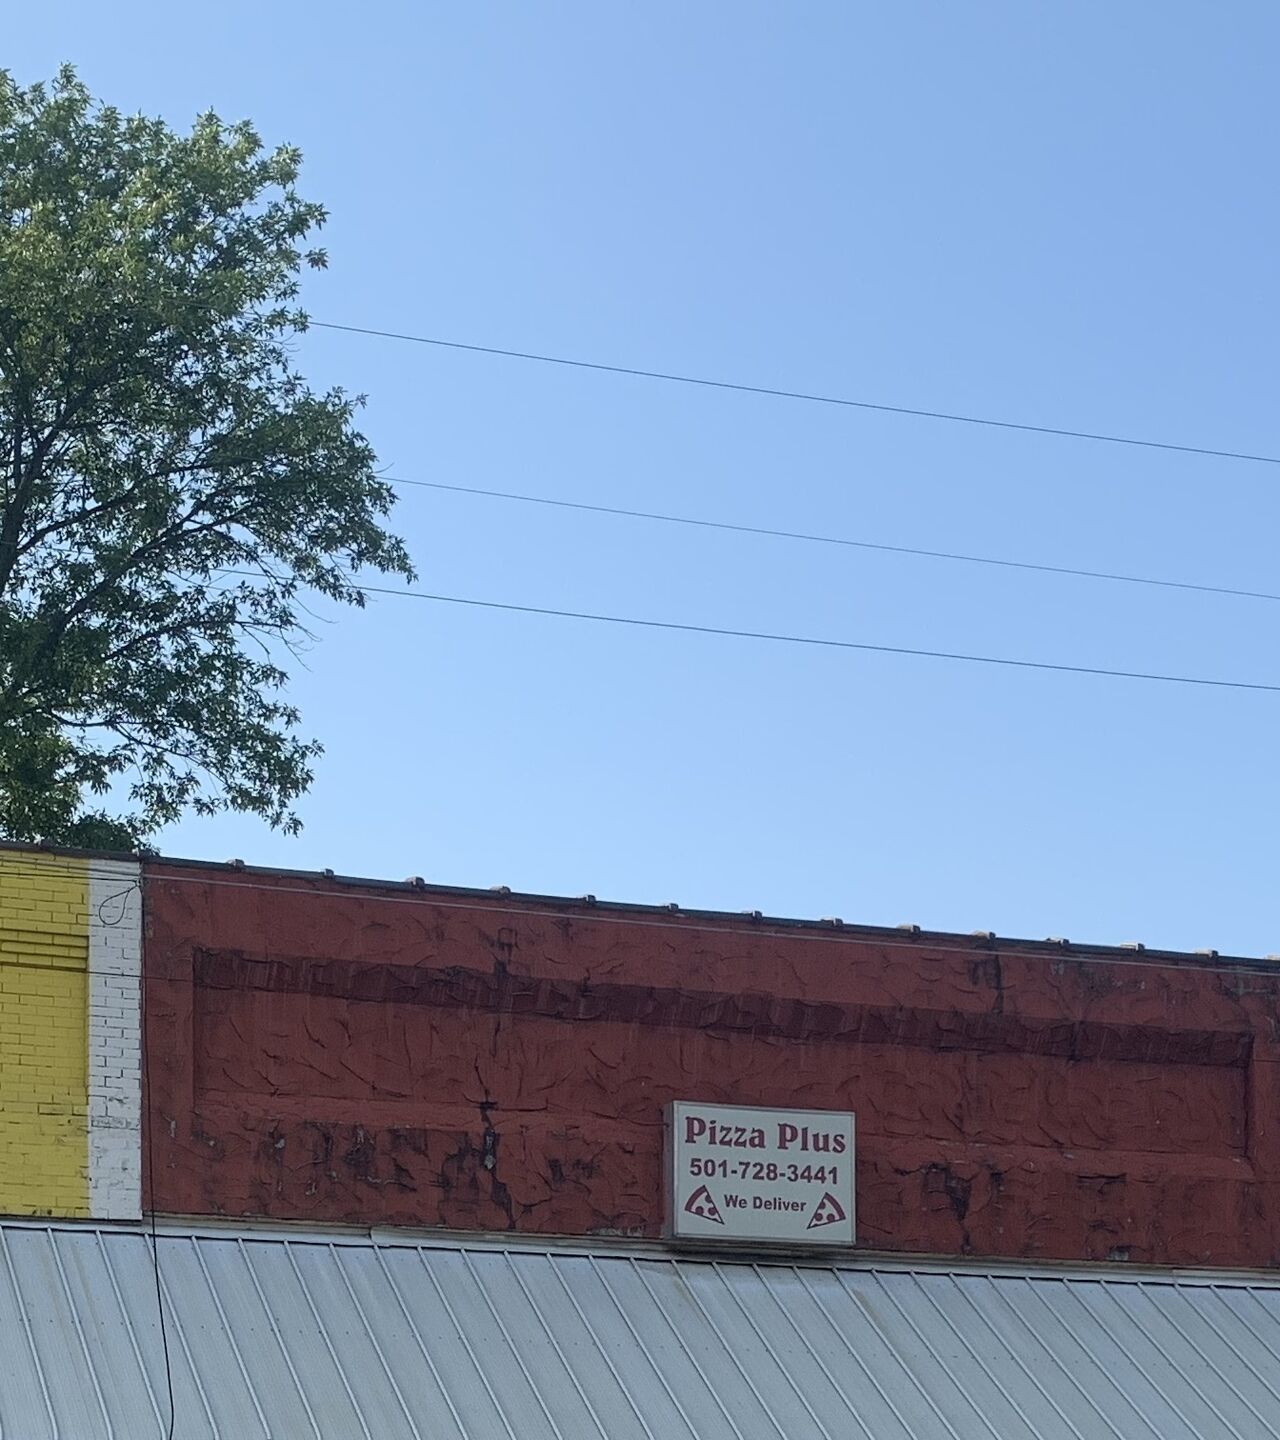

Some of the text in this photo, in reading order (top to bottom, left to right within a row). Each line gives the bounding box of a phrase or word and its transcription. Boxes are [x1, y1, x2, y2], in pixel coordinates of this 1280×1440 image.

[685, 1116, 846, 1154] Pizza Plus
[690, 1158, 838, 1184] 501-728-3441
[724, 1194, 807, 1211] We Deliver
